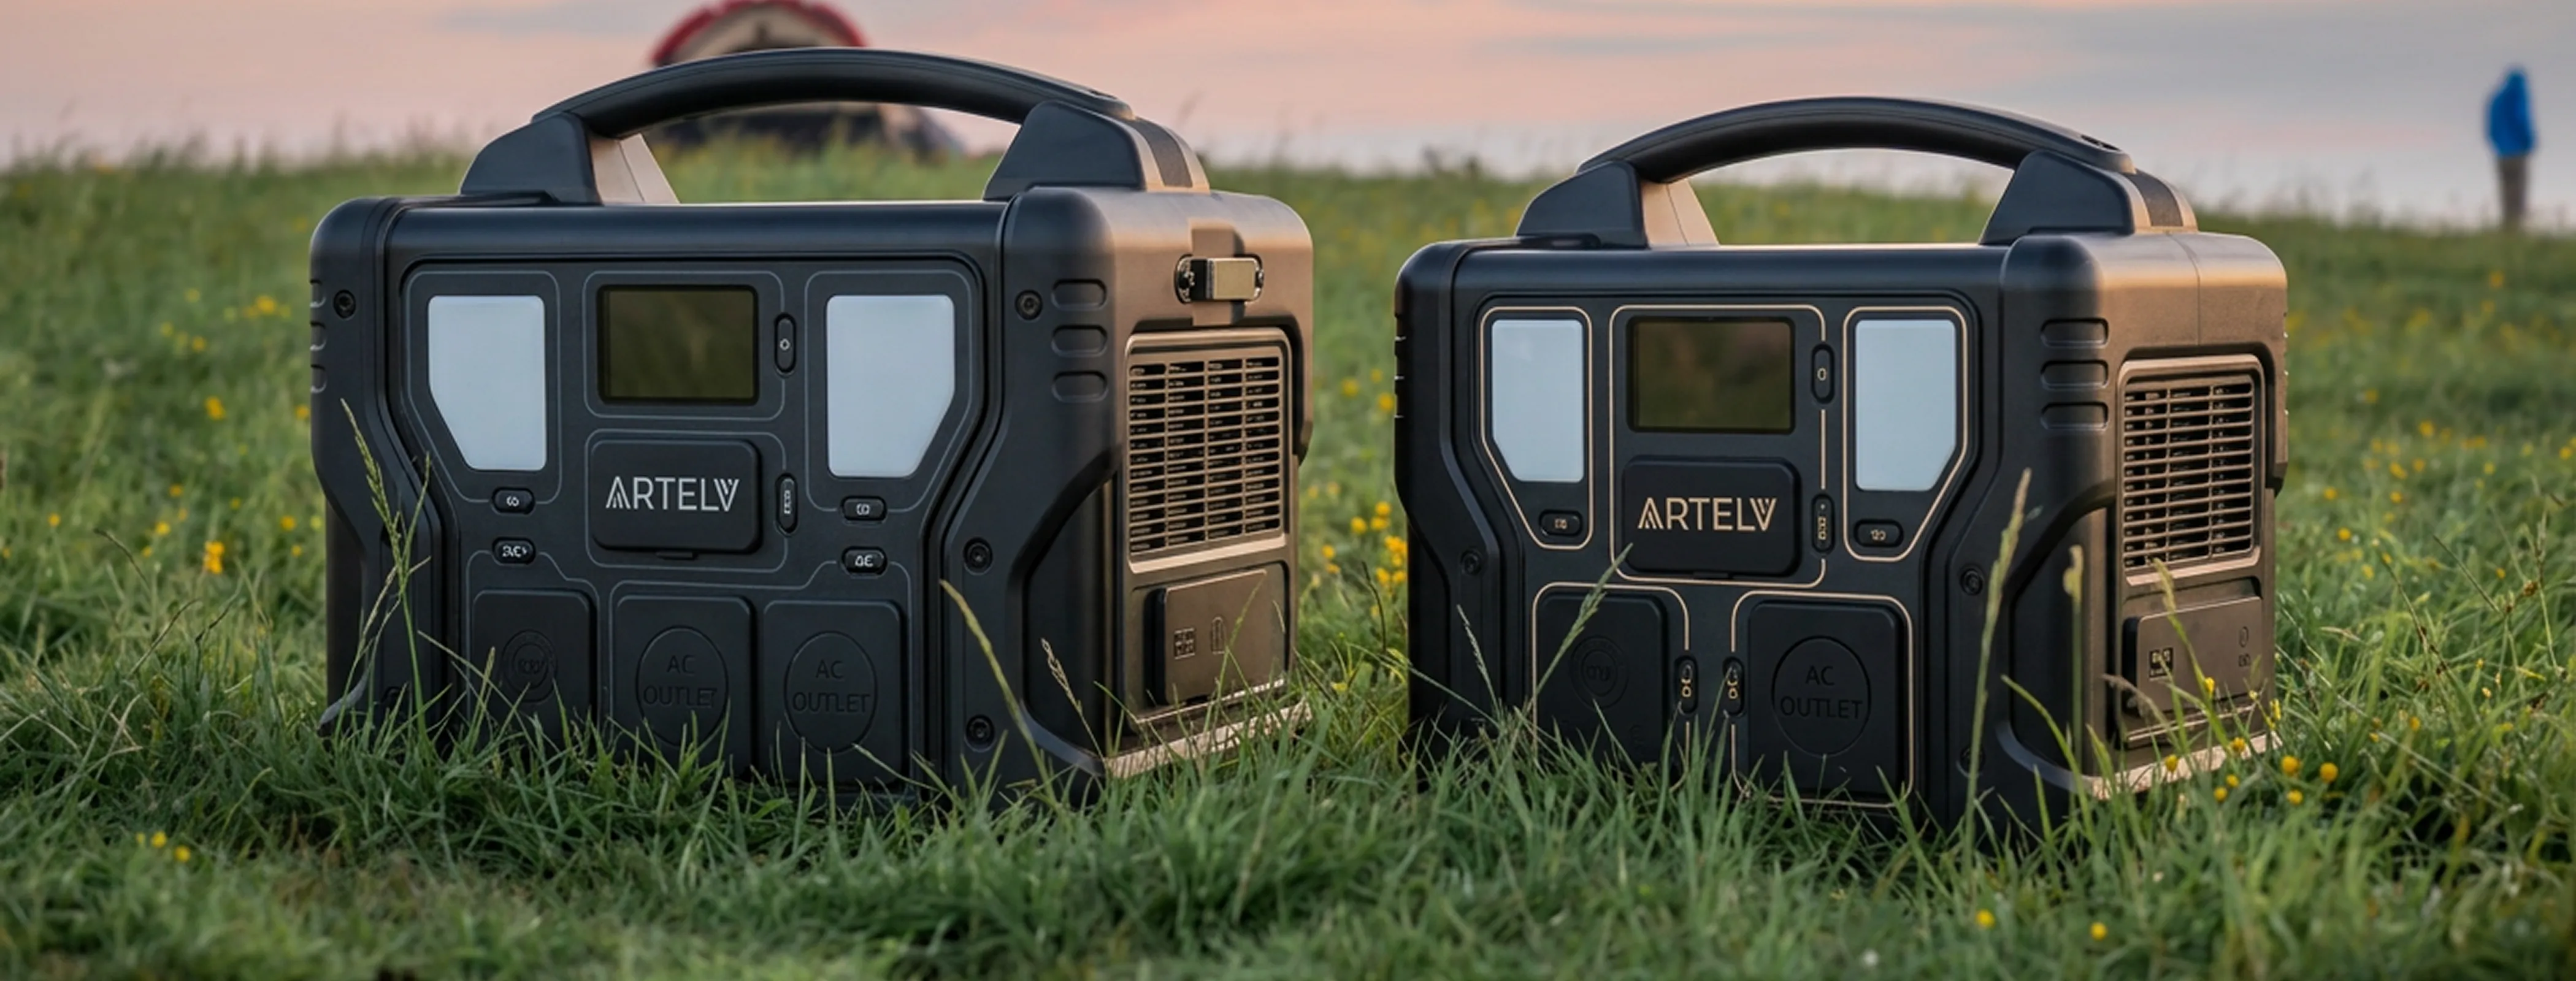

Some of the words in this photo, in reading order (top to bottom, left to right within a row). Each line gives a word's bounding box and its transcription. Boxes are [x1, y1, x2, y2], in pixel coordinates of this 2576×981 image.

[666, 654, 696, 674] AC
[815, 658, 845, 679] AC
[1804, 665, 1836, 686] AC
[643, 685, 718, 708] OUTLET
[792, 692, 871, 713] OUTLET
[1780, 695, 1863, 719] OUTLET
